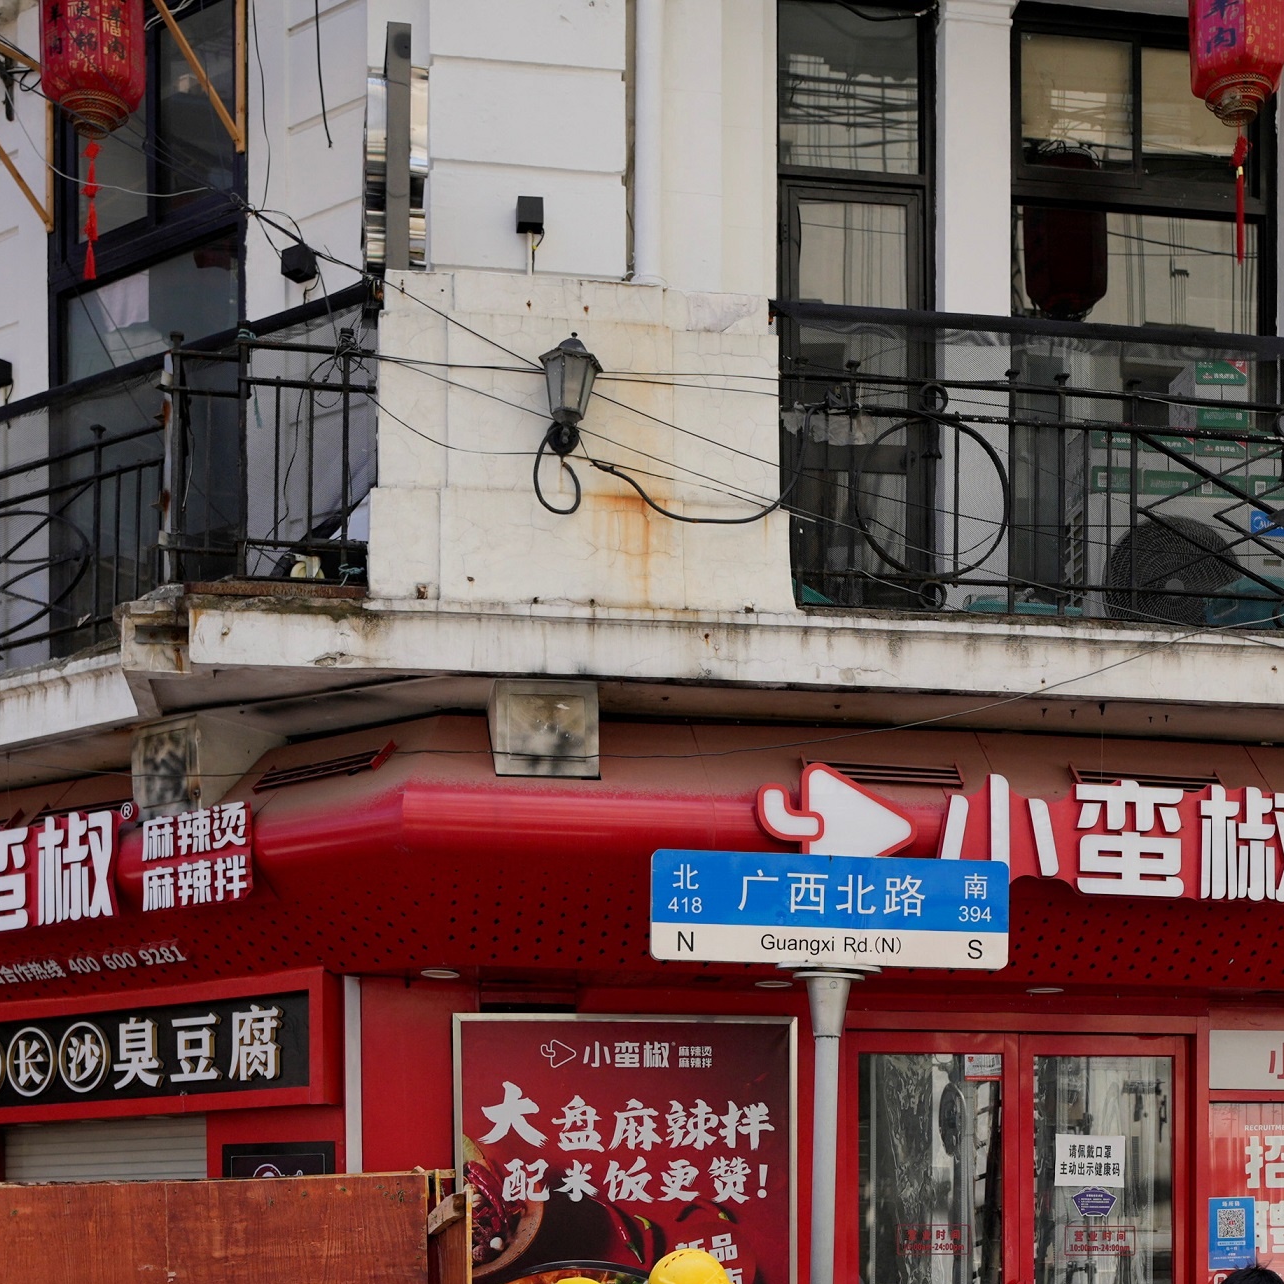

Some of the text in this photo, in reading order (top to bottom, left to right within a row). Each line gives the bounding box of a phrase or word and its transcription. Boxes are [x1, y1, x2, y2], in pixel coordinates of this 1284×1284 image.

[142, 801, 248, 862] 麻辣烫
[142, 855, 248, 912] 麻辣拌
[672, 864, 988, 917] 北 广西北路 南
[668, 897, 992, 923] 418 394
[677, 931, 984, 959] N Guangxi Rd.(N) S
[69, 956, 101, 974] 400
[103, 951, 137, 970] 600
[138, 945, 187, 966] 9281
[583, 1041, 669, 1068] 小蛮椒
[678, 1046, 712, 1056] 麻辣烫
[678, 1058, 712, 1068] 麻辣拌
[478, 1081, 776, 1153] 大盘麻辣拌
[1069, 1144, 1112, 1159] 请佩戴口罩
[502, 1158, 769, 1203] 配米饭更赞!
[1060, 1162, 1120, 1176] 主动出示健康码
[1070, 1244, 1130, 1253] 10:00am-24:00pm
[1074, 1230, 1125, 1242] 营业时间
